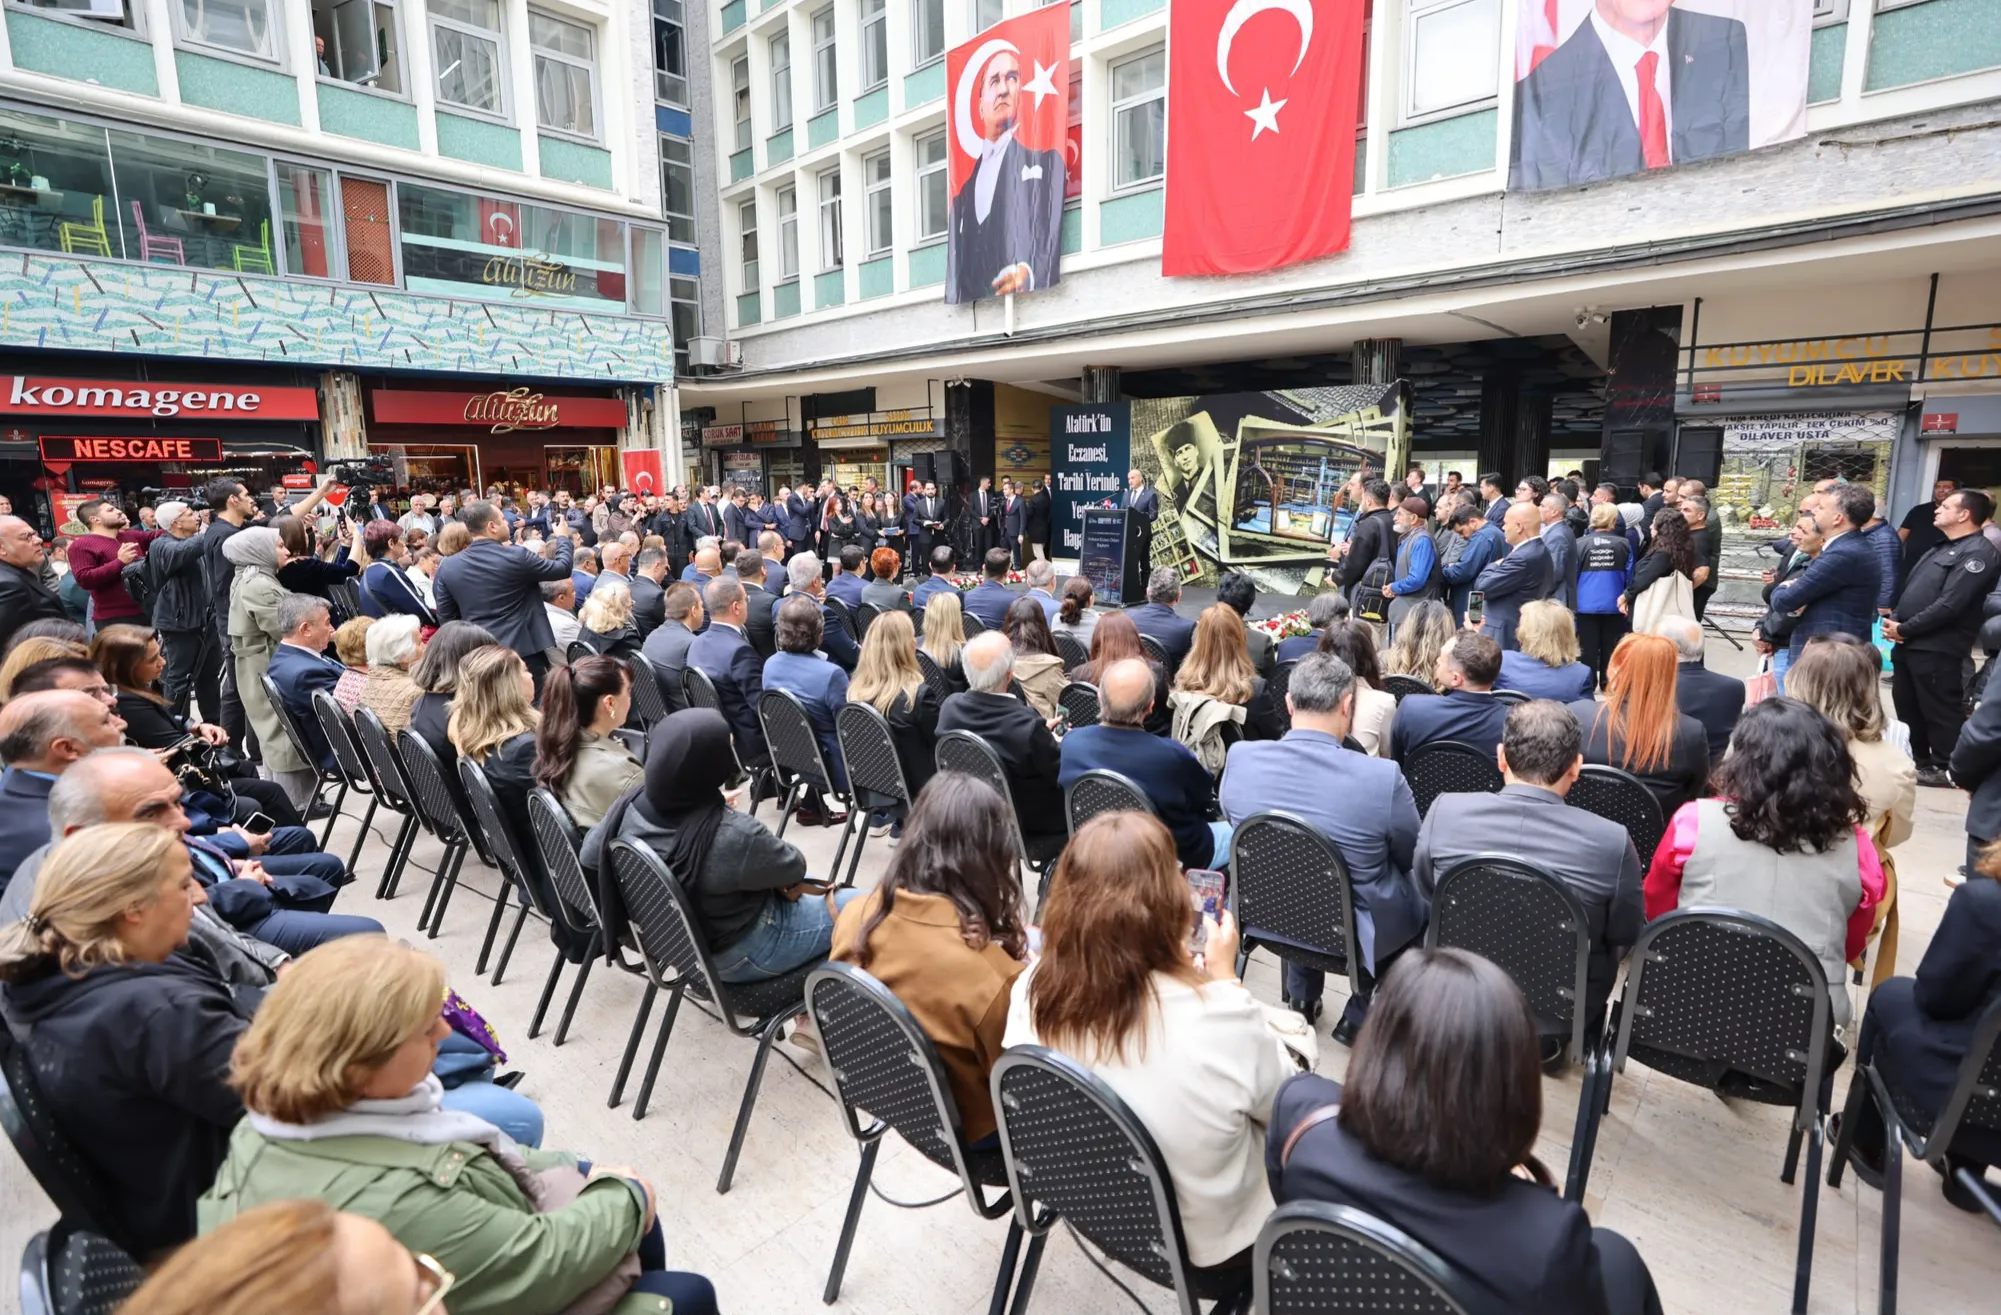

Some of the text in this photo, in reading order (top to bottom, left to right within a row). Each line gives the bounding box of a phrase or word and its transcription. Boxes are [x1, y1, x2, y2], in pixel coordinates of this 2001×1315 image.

[1705, 335, 1889, 368] KUYUMCU
[10, 376, 260, 416] komagene
[1065, 413, 1112, 433] Atatürk'ün
[1796, 430, 1829, 439] USTA
[73, 439, 192, 458] NESCAFE
[1068, 442, 1109, 463] Eczanesi,
[1085, 472, 1120, 491] Yerinde
